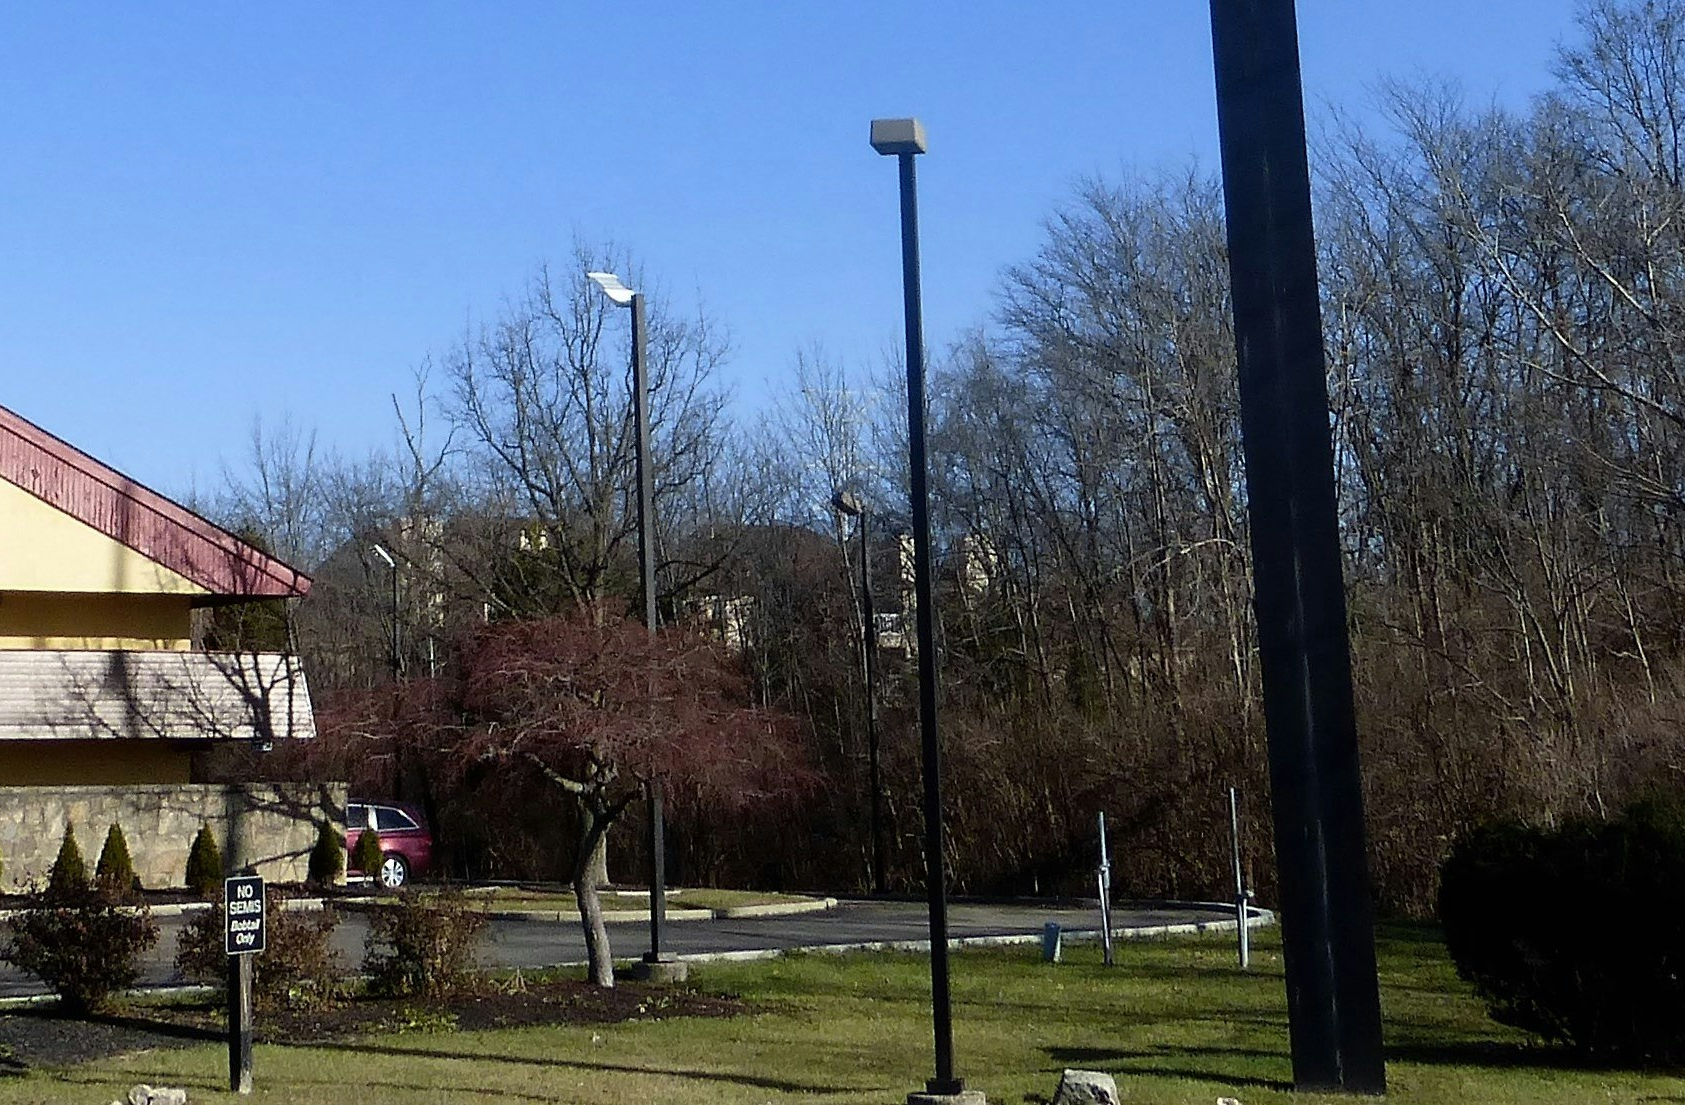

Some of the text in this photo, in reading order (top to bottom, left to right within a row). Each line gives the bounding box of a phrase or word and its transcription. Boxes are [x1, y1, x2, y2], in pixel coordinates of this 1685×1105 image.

[237, 884, 254, 899] NO
[229, 899, 261, 915] SEMIS
[236, 932, 255, 946] Only
